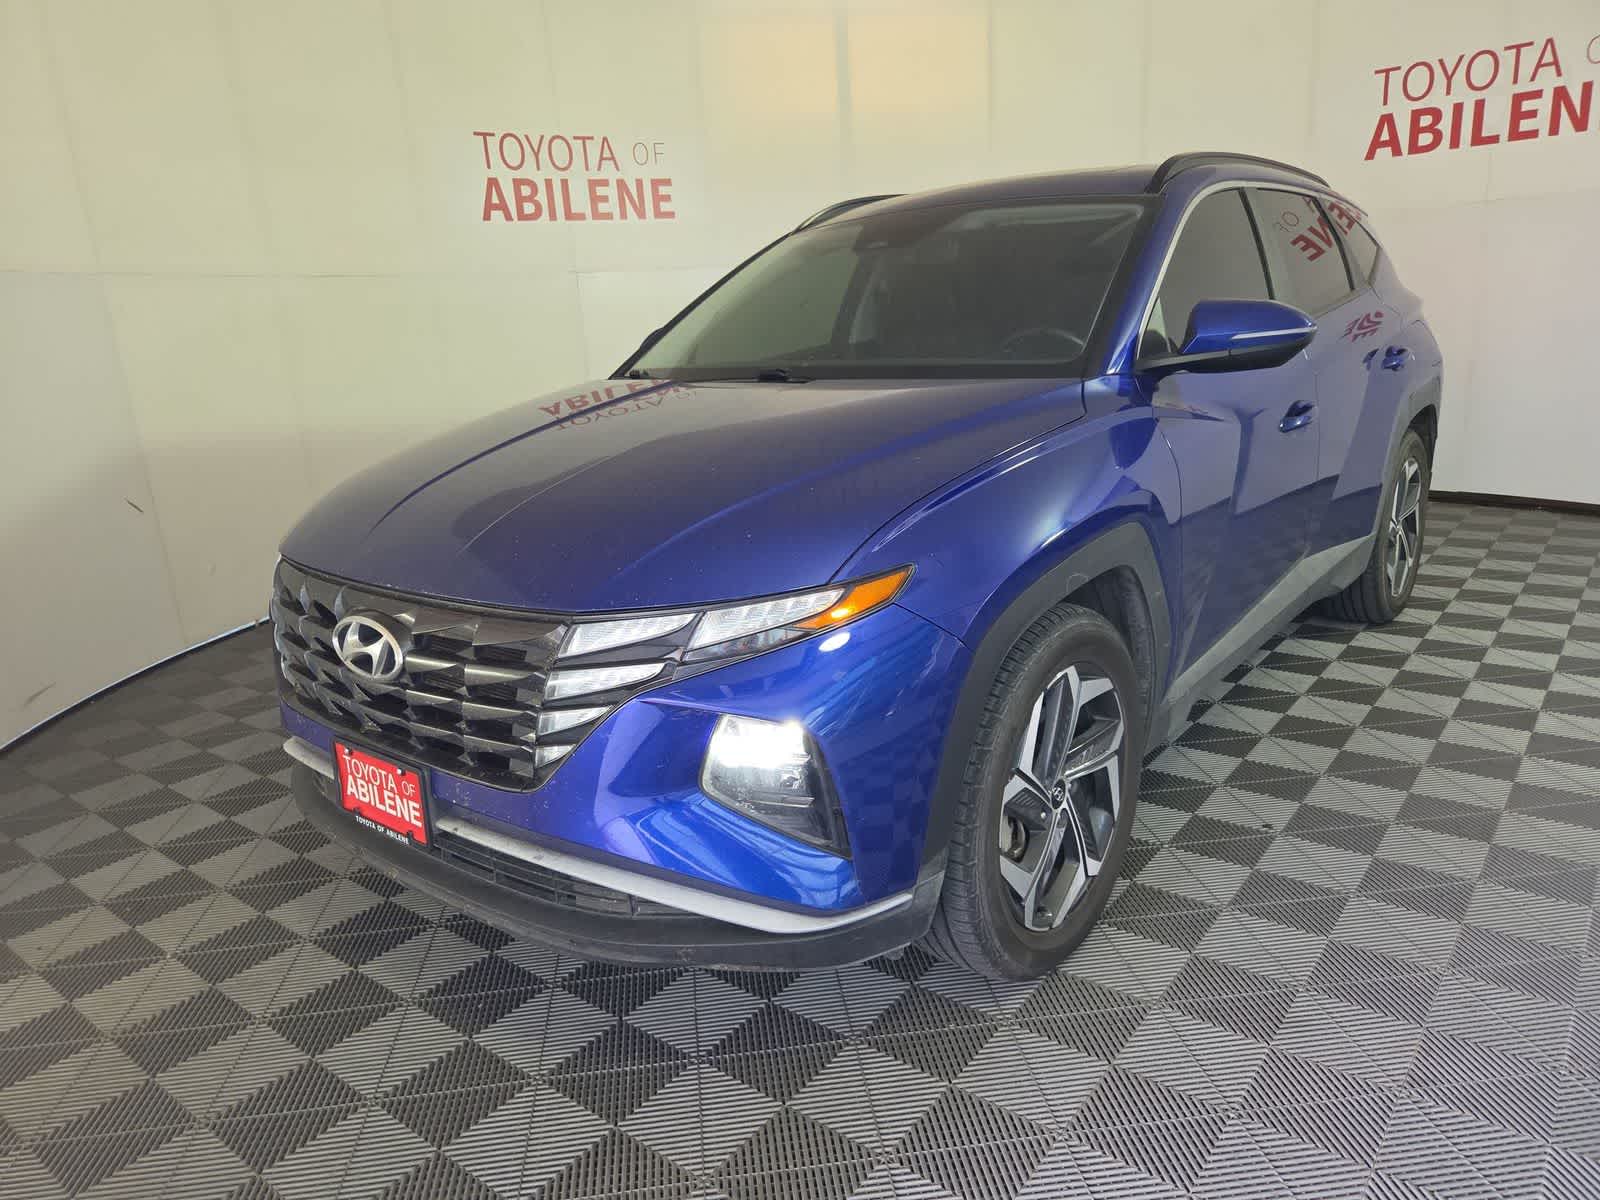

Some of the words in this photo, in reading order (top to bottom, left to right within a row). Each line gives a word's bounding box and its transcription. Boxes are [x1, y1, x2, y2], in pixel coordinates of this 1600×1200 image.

[1374, 37, 1563, 106] TOYOTA
[1364, 80, 1600, 161] ABILEN
[473, 131, 620, 172] TOYOTA
[632, 142, 665, 166] OF
[482, 177, 676, 221] ABILENE
[343, 754, 398, 793] TOYOTA
[401, 781, 416, 797] OF
[347, 775, 422, 827] ABILENE
[355, 815, 376, 829] TOYOTA
[377, 825, 385, 833] OF
[386, 829, 409, 845] ABILENE
